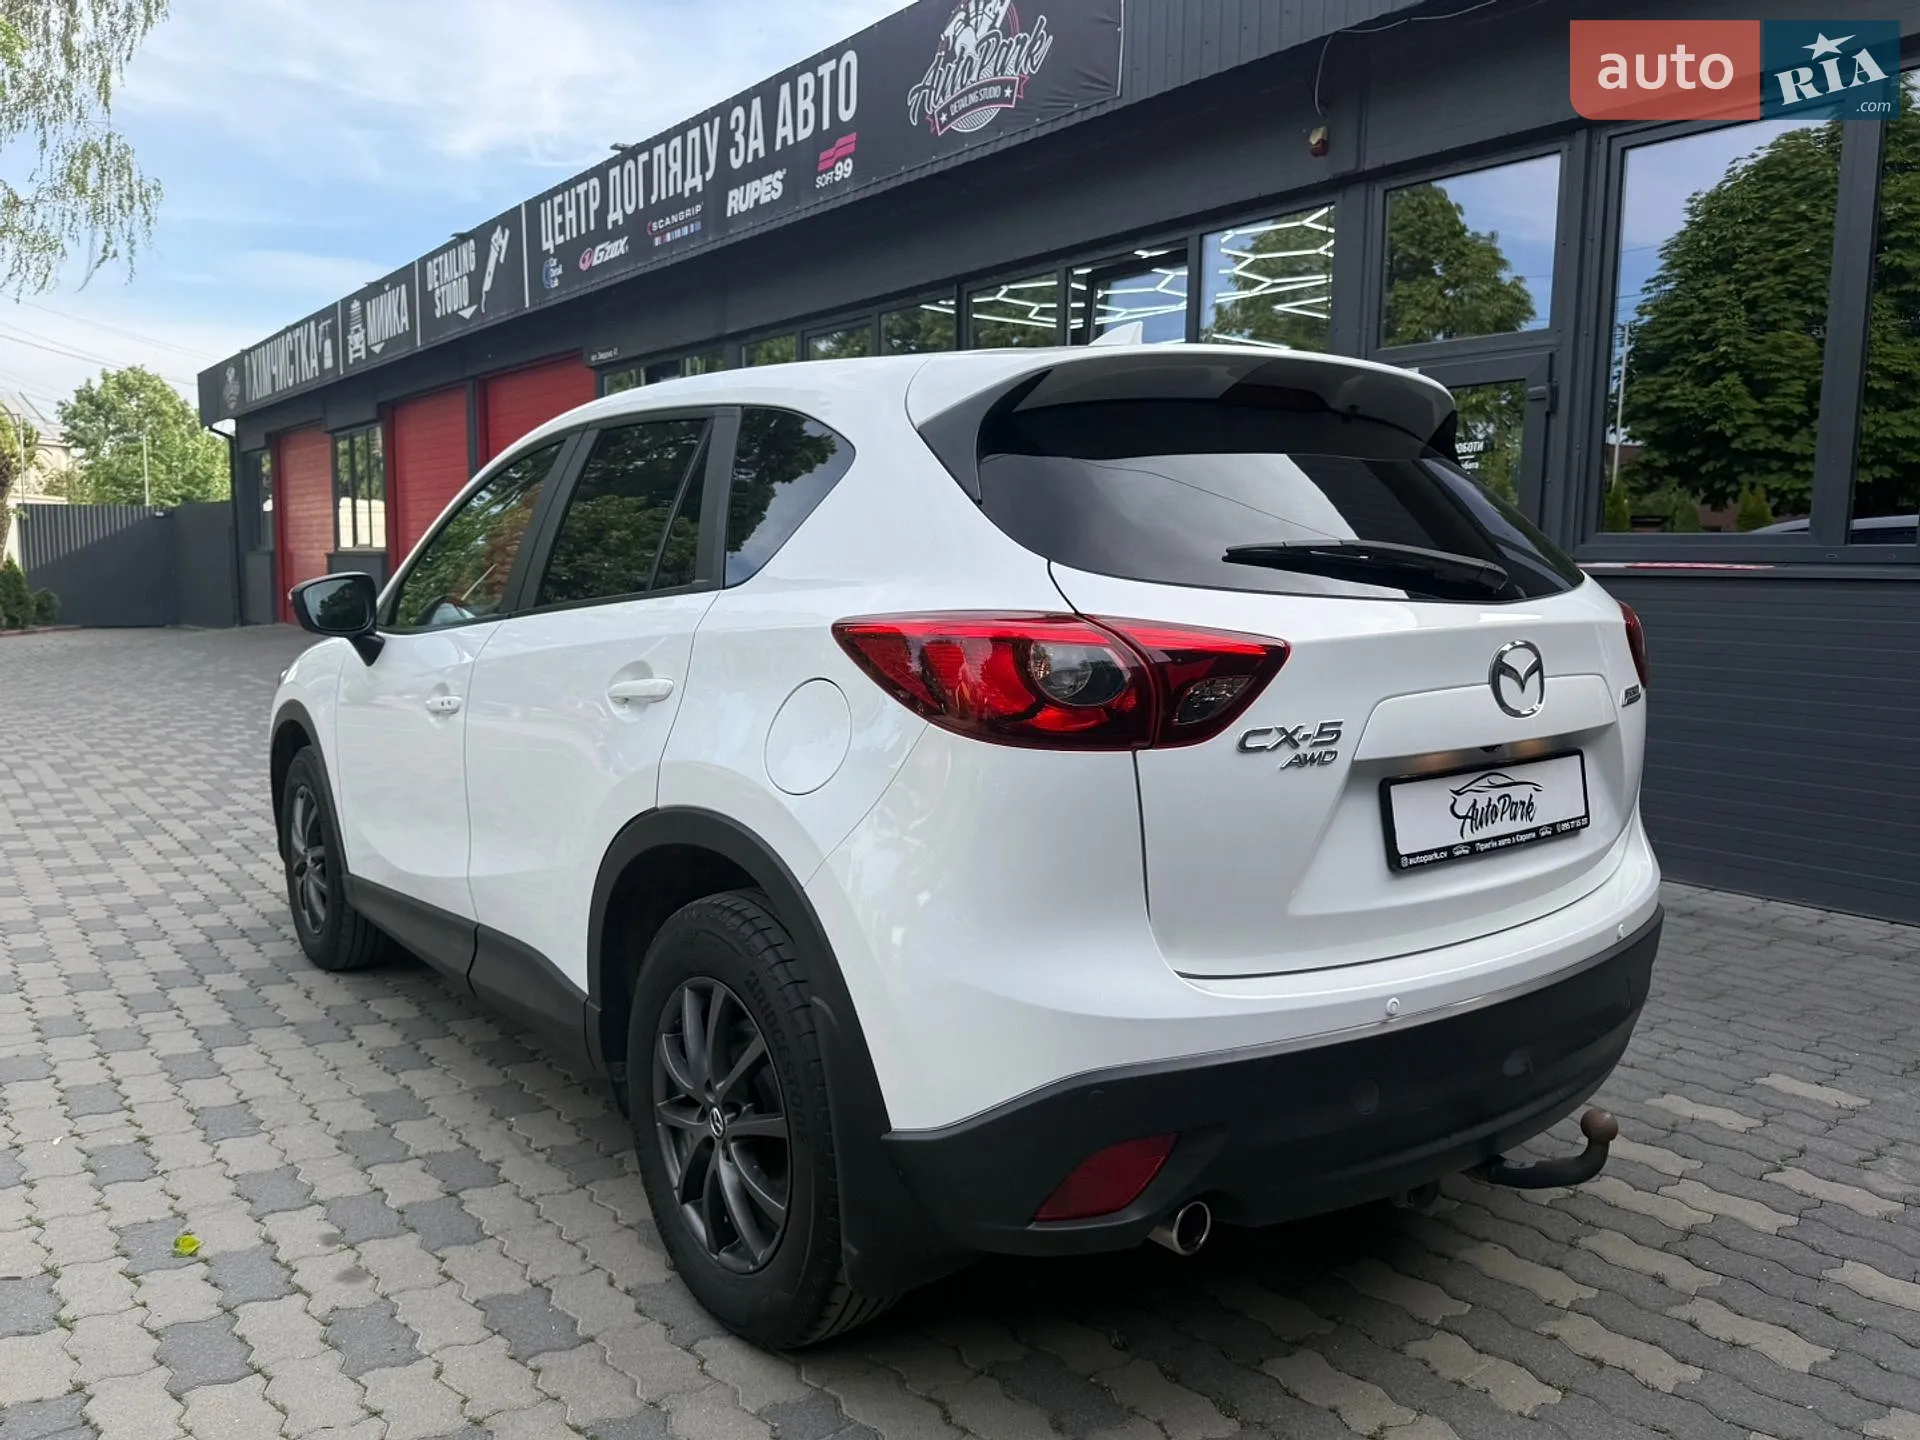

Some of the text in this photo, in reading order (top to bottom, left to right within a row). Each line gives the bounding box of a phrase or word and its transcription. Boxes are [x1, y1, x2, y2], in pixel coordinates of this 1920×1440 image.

[950, 85, 1001, 116] DETAILING STUDIO
[540, 49, 858, 254] ЦЕНТР ДОГЛЯДУ ЗА АВТО
[726, 171, 783, 218] RUPES
[652, 203, 702, 232] SCANGRIP
[427, 239, 476, 292] DETAILING
[367, 283, 410, 345] МИЙКА
[435, 275, 471, 319] STUDIO
[251, 321, 320, 401] ХІМЧИСТКА
[1455, 441, 1484, 453] ОБОТИ
[1236, 719, 1345, 754] CX-5
[1280, 750, 1338, 771] AWD
